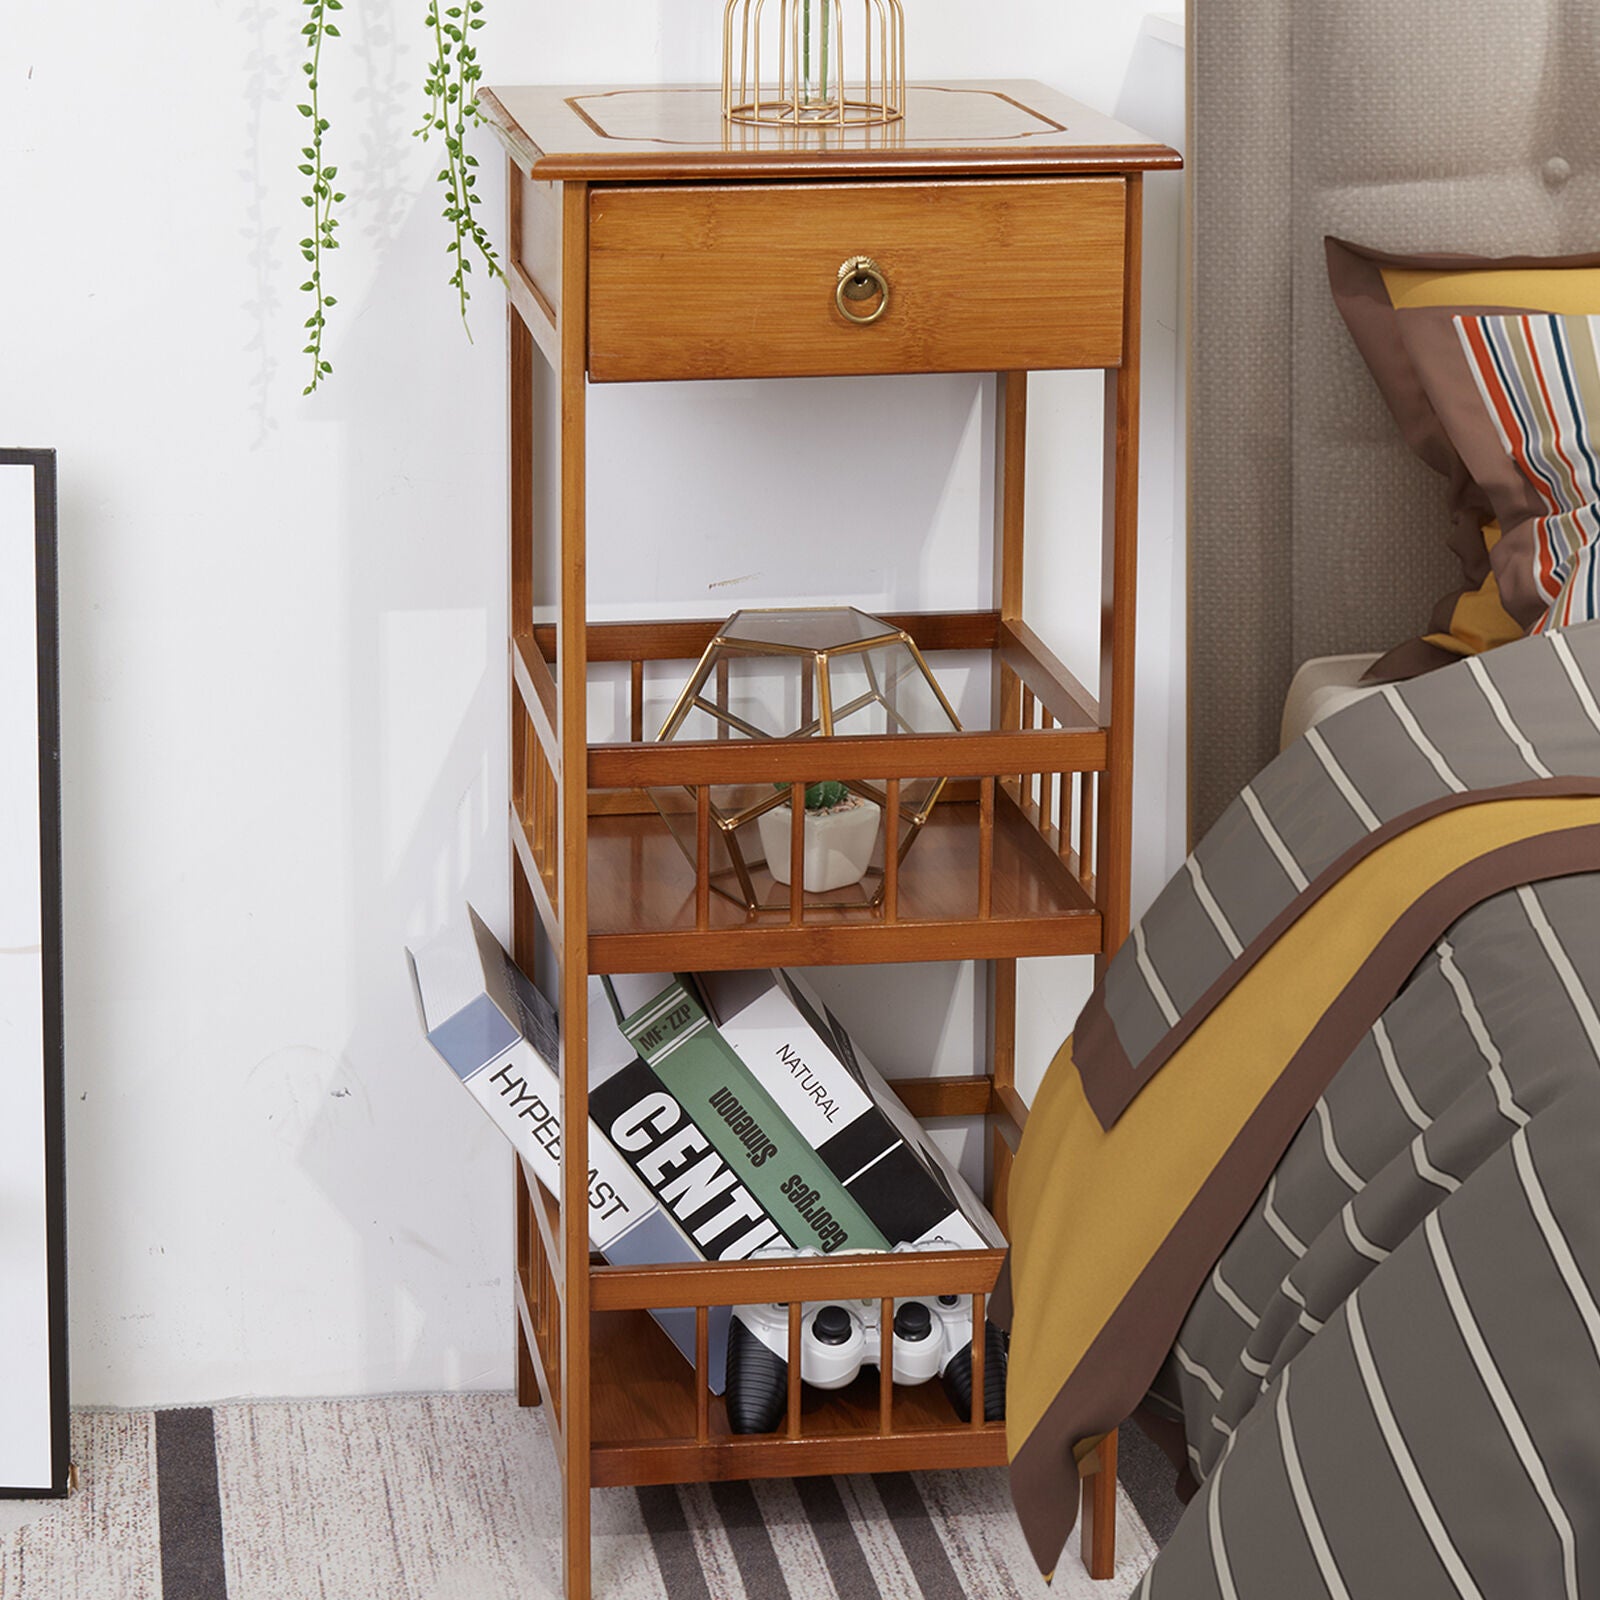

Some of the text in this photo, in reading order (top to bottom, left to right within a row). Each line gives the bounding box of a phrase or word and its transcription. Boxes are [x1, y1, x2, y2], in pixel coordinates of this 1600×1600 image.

[776, 1043, 840, 1123] NATURAL
[708, 1086, 848, 1253] Georges Simenon
